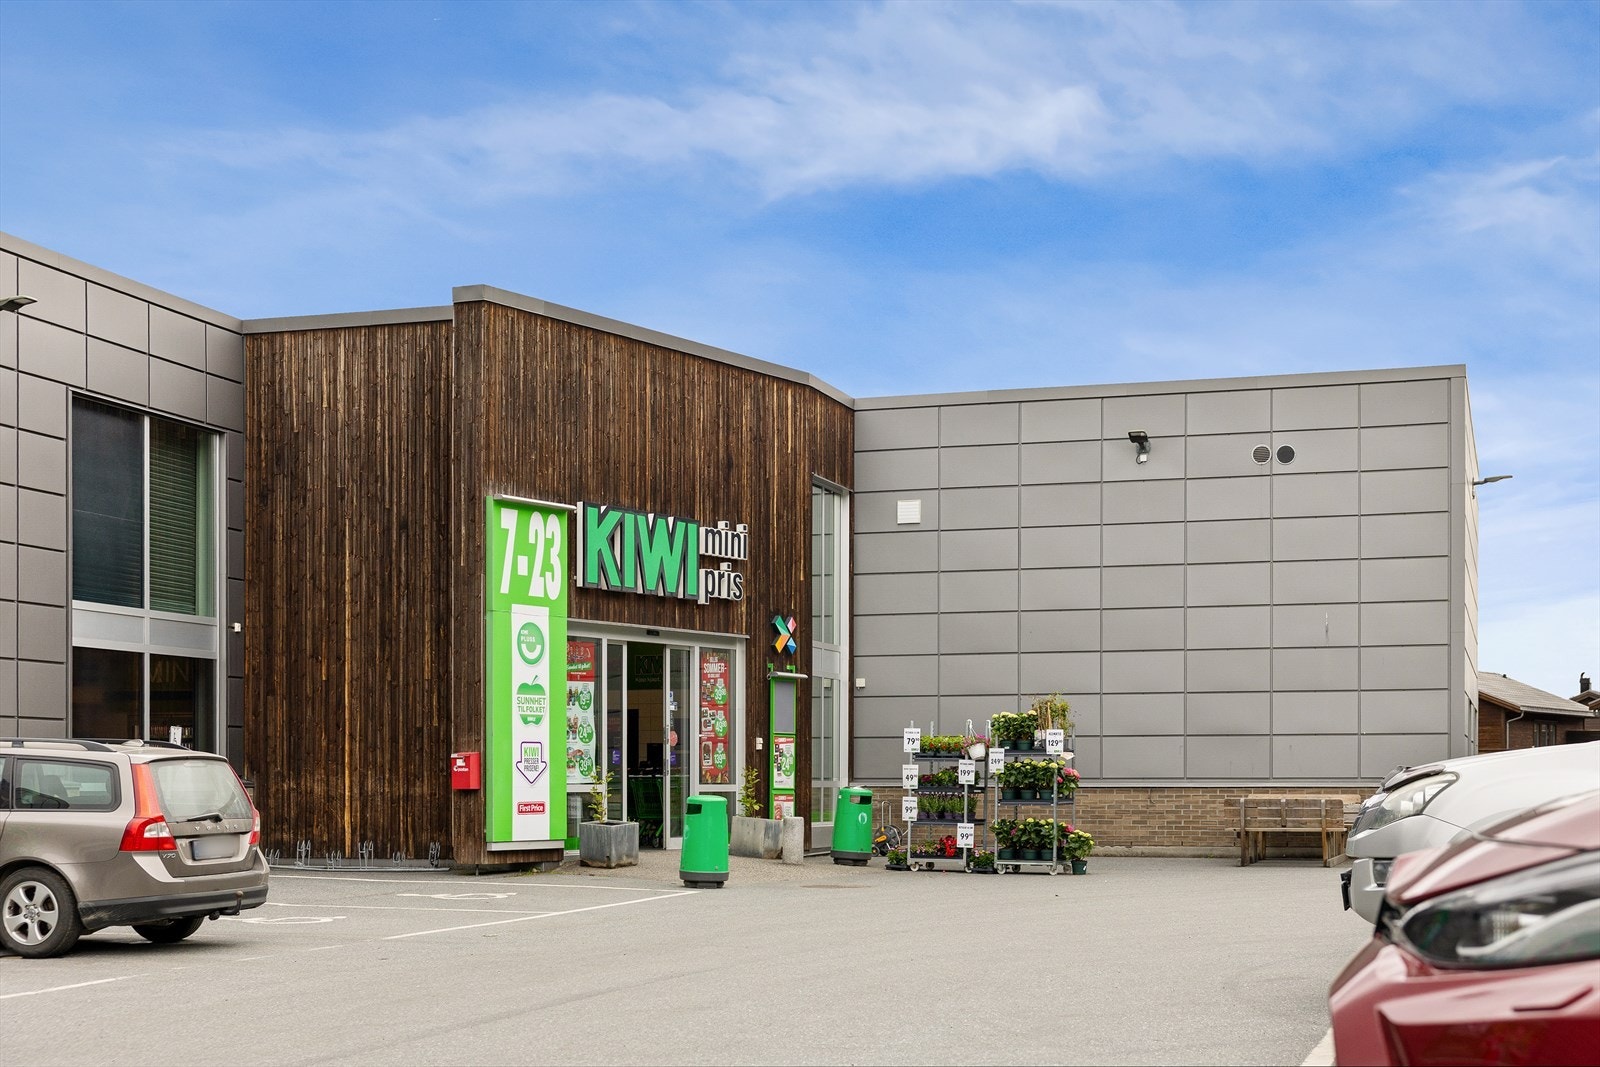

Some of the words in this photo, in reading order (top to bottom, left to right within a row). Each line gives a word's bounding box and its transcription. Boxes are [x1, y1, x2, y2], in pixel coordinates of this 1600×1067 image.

[704, 522, 747, 559] mini
[500, 508, 561, 600] 7-23
[584, 503, 699, 599] KIWI
[704, 563, 743, 604] pris
[516, 696, 546, 706] SUNNHET
[526, 705, 546, 713] FOLKET
[579, 726, 588, 738] 24
[906, 737, 916, 746] 79
[1048, 739, 1059, 747] 129
[523, 746, 540, 757] KIWI
[580, 758, 588, 771] 39
[905, 774, 914, 782] 49
[519, 804, 531, 812] First
[531, 804, 544, 812] Price
[904, 806, 914, 814] 99
[960, 832, 970, 841] 99
